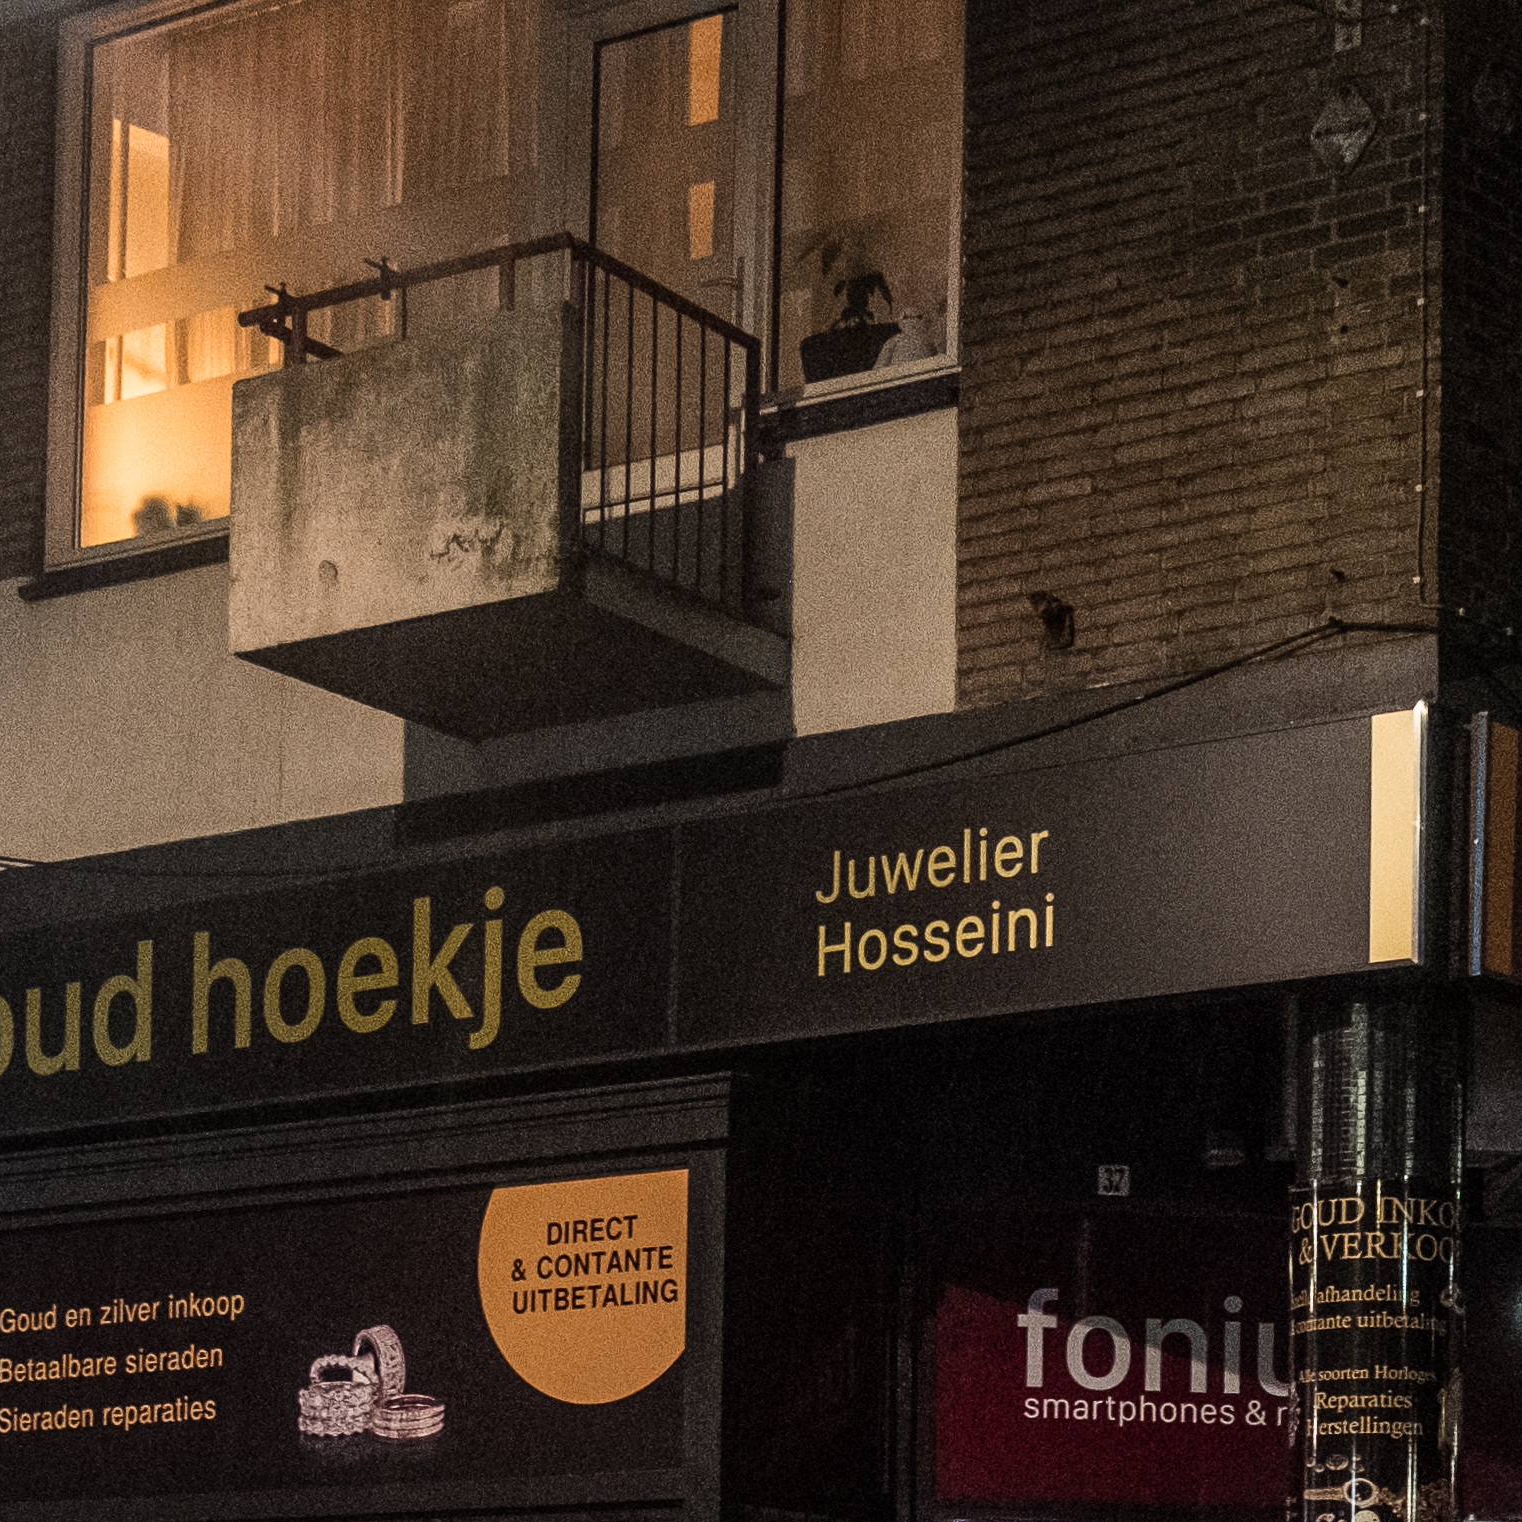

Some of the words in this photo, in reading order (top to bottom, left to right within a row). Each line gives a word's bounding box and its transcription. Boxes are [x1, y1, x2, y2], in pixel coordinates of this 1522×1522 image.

[815, 827, 1049, 904] Juwelier
[817, 892, 1055, 977] Hosseini
[193, 886, 586, 1054] hoekje
[546, 1214, 639, 1245] DIRECT
[511, 1257, 528, 1281] &
[536, 1245, 675, 1280] CONTANTE
[65, 1306, 92, 1328] en
[99, 1296, 161, 1326] zilver
[167, 1291, 246, 1326] inkoop
[512, 1278, 679, 1315] UITBETALING
[1017, 1288, 1291, 1396] foniu
[125, 1344, 223, 1376] sieraden
[1318, 1368, 1369, 1382] soorten
[101, 1395, 217, 1430] reparaties
[1023, 1396, 1235, 1427] smartphones
[1245, 1400, 1267, 1426] &
[1314, 1390, 1413, 1412] Reparaties
[1307, 1416, 1424, 1439] Herstellingen
